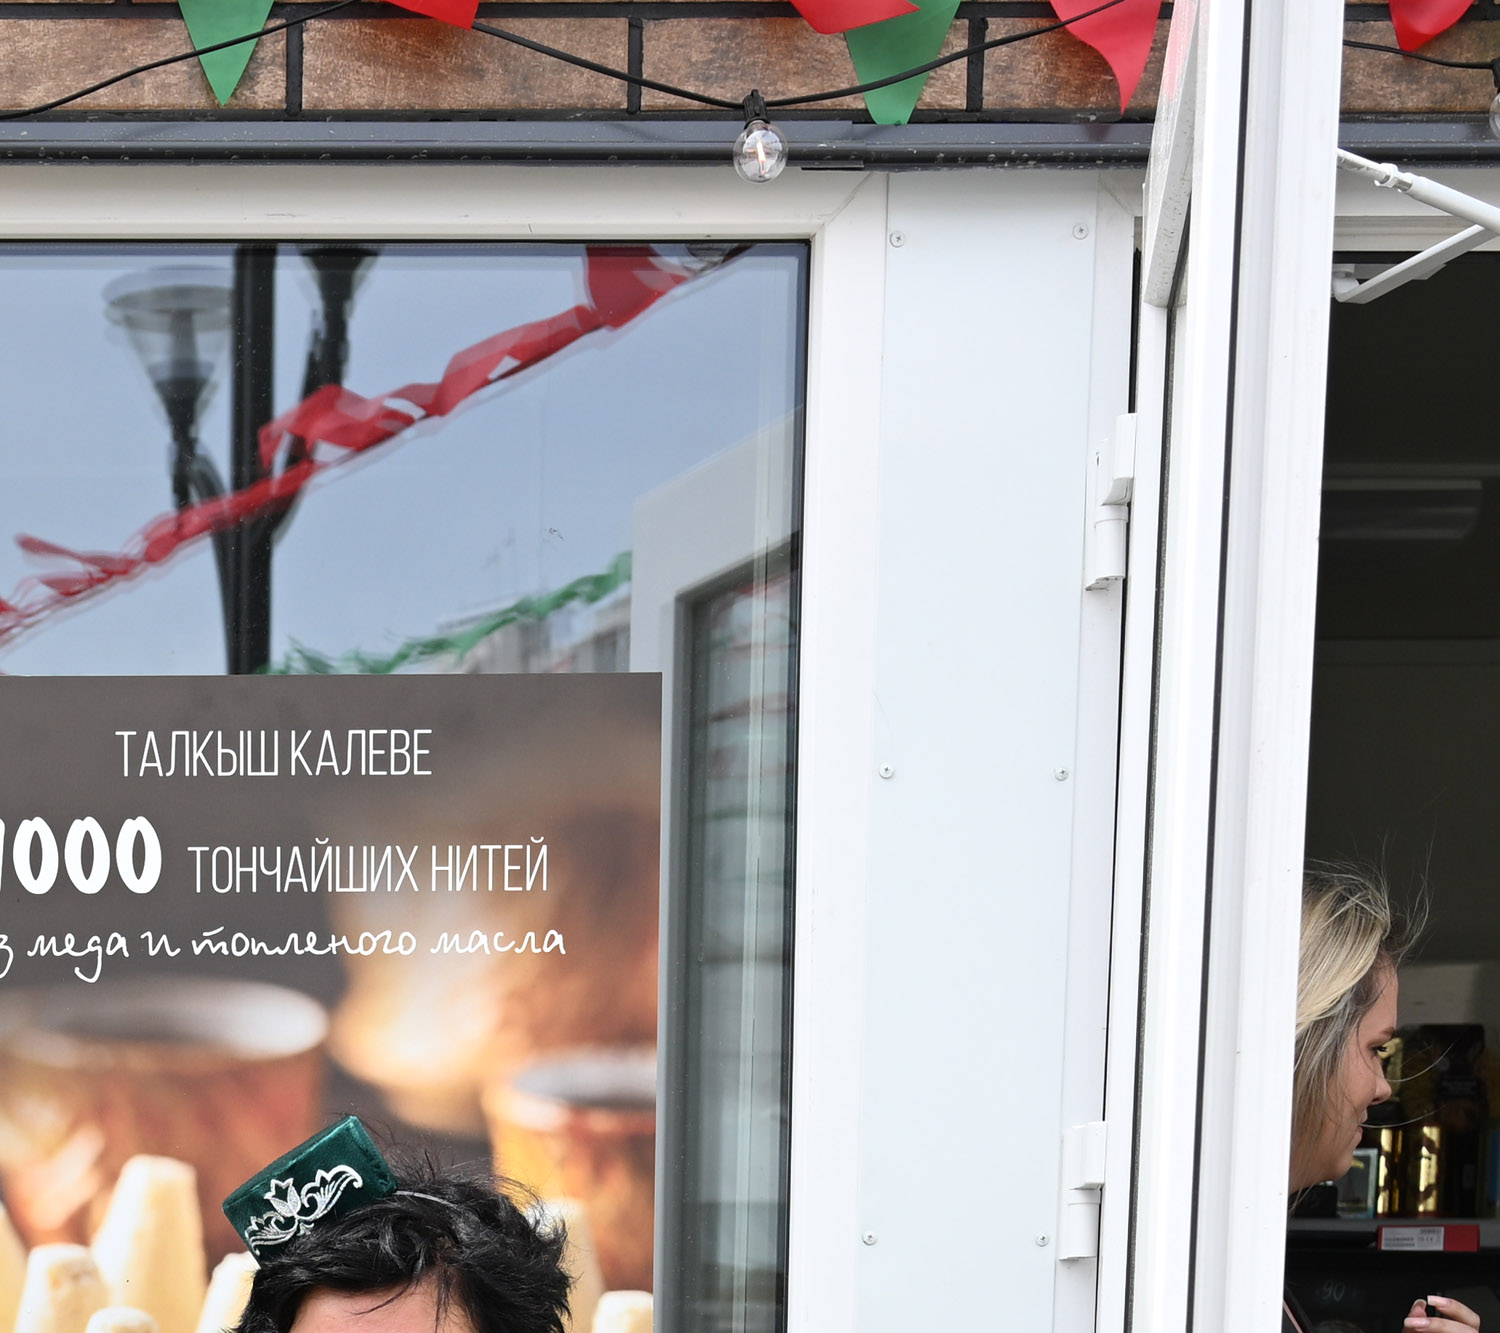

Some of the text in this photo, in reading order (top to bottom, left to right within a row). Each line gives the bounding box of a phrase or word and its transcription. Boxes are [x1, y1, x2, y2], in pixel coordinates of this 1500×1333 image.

[115, 729, 432, 776] ТАЛКЫШ КАЛЕВЕ
[187, 837, 419, 894] ТОНЧАЙШИХ
[431, 836, 548, 892] НИТЕЙ
[27, 932, 129, 983] меда
[141, 930, 180, 957] и
[191, 927, 416, 957] топленого
[430, 931, 566, 956] масла
